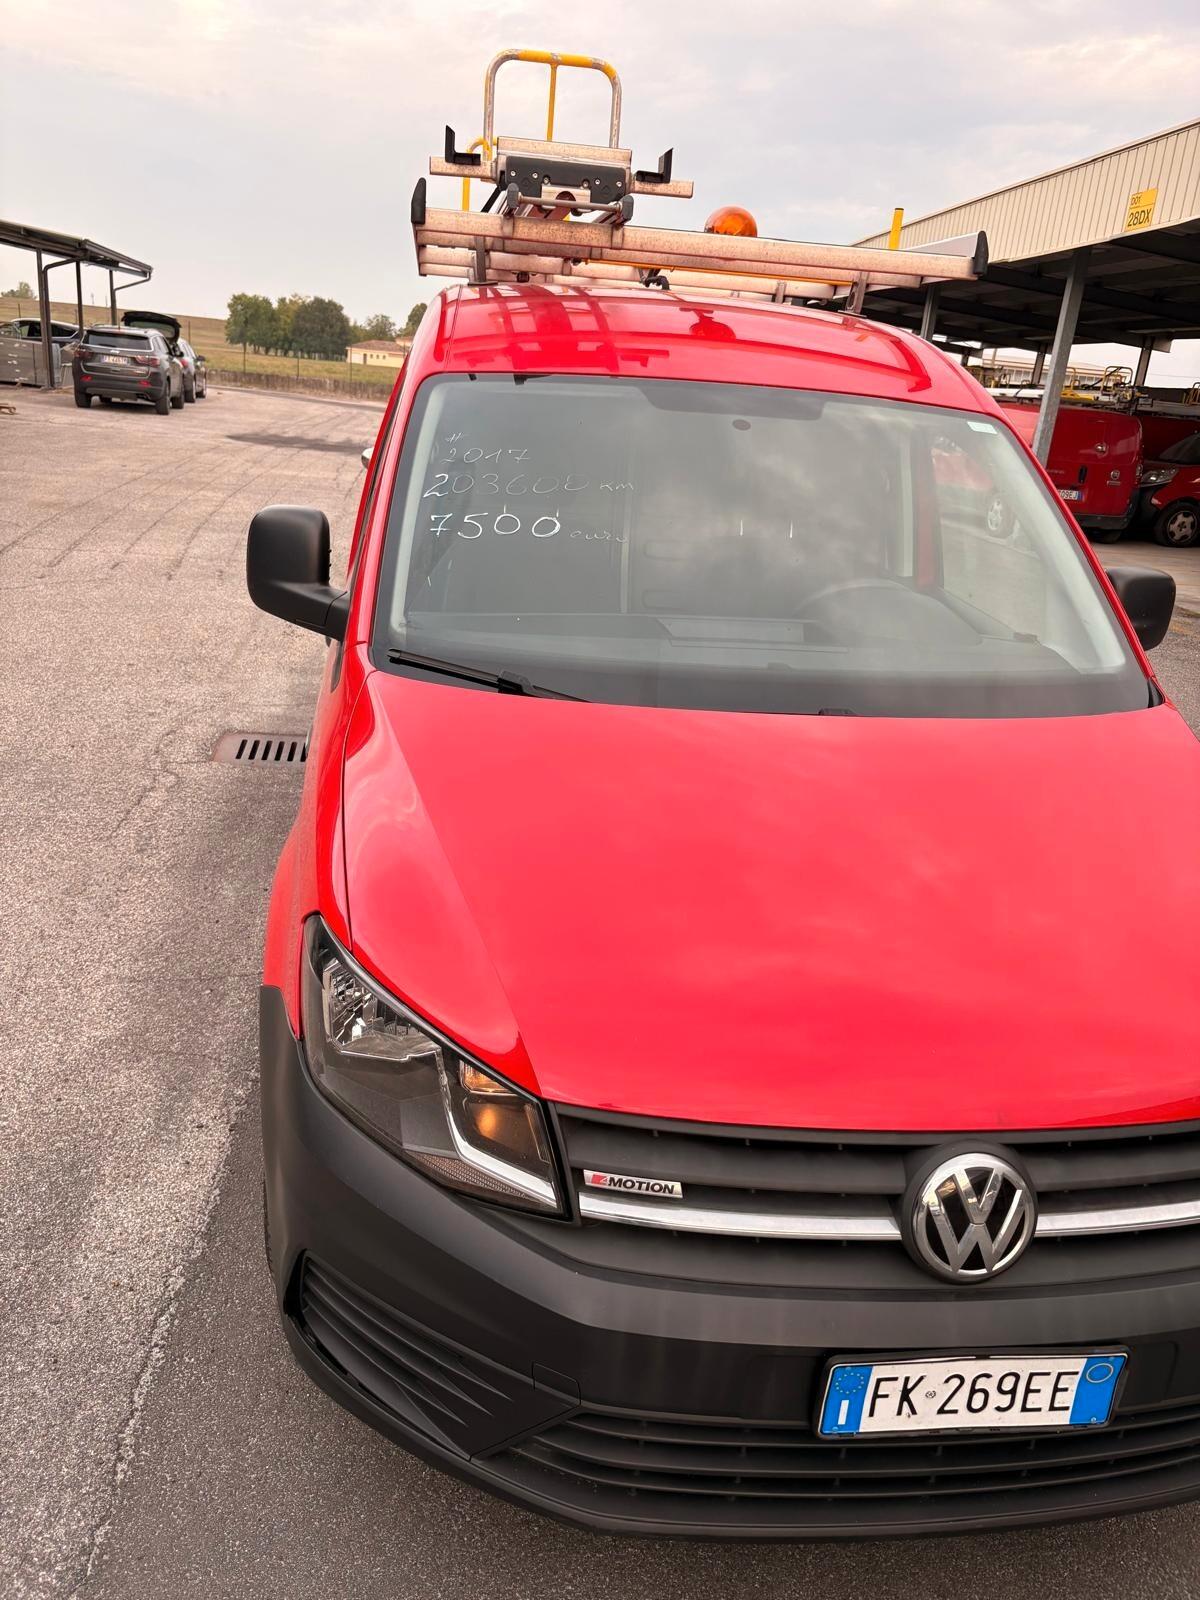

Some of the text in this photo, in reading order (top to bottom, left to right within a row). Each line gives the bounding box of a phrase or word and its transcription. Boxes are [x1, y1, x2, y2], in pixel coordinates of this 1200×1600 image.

[1127, 208, 1152, 227] 28DX
[440, 447, 530, 464] 2017
[429, 505, 560, 538] 7500
